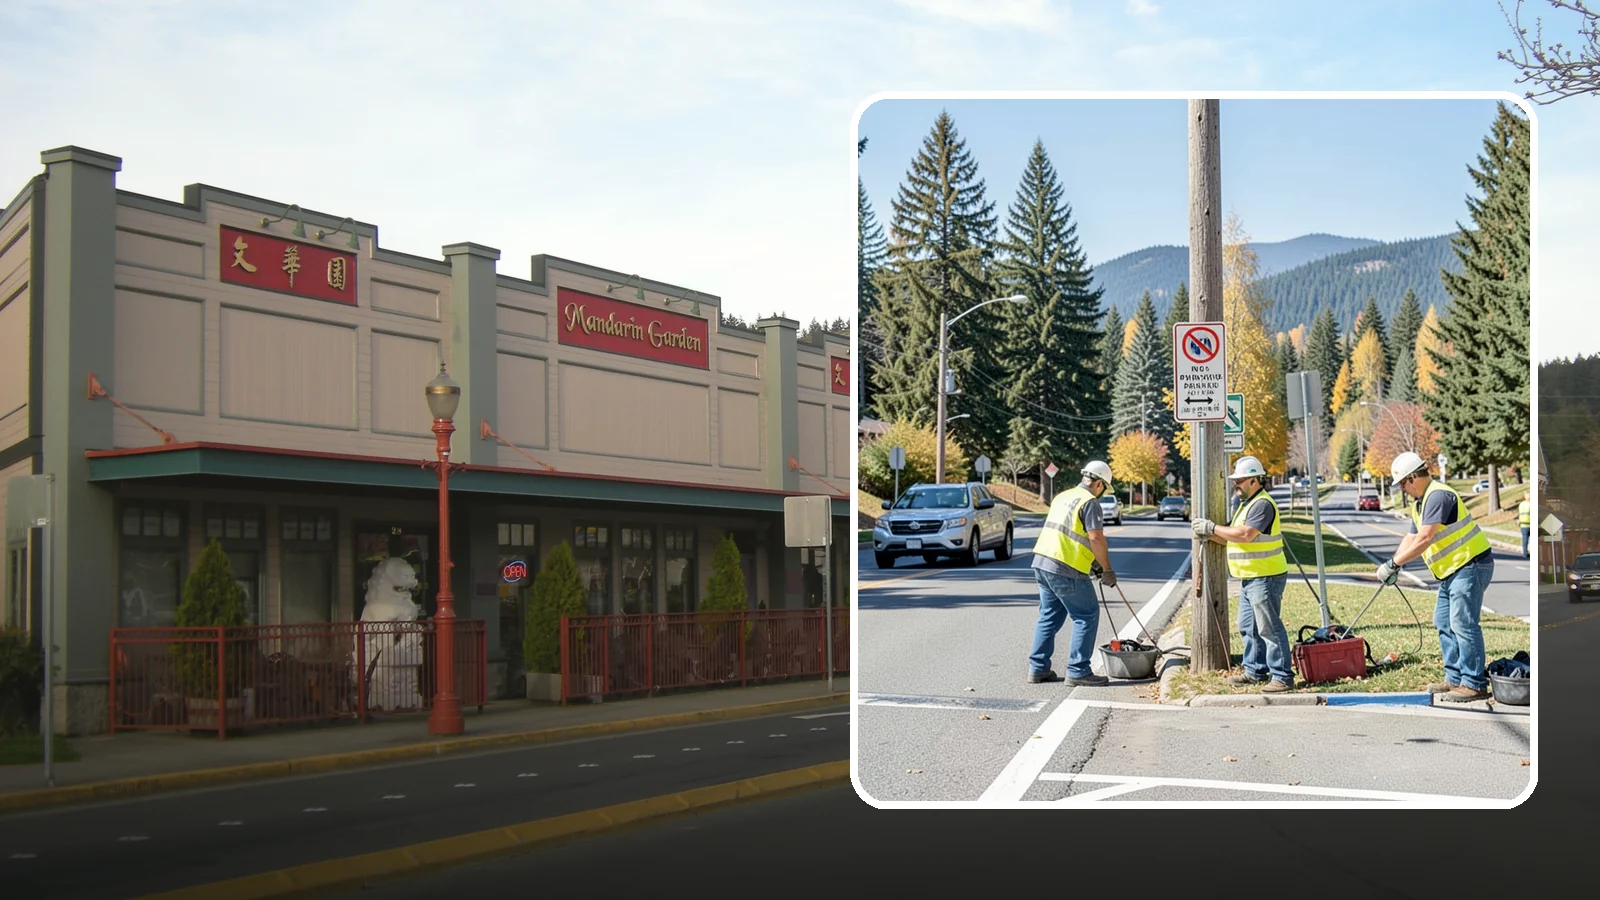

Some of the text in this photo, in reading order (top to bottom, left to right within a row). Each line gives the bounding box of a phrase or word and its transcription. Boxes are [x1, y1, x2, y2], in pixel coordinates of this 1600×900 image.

[230, 235, 346, 291] 文華園
[564, 302, 701, 352] Mandarin Garden
[834, 363, 846, 386] 文
[503, 565, 527, 578] OPEN
